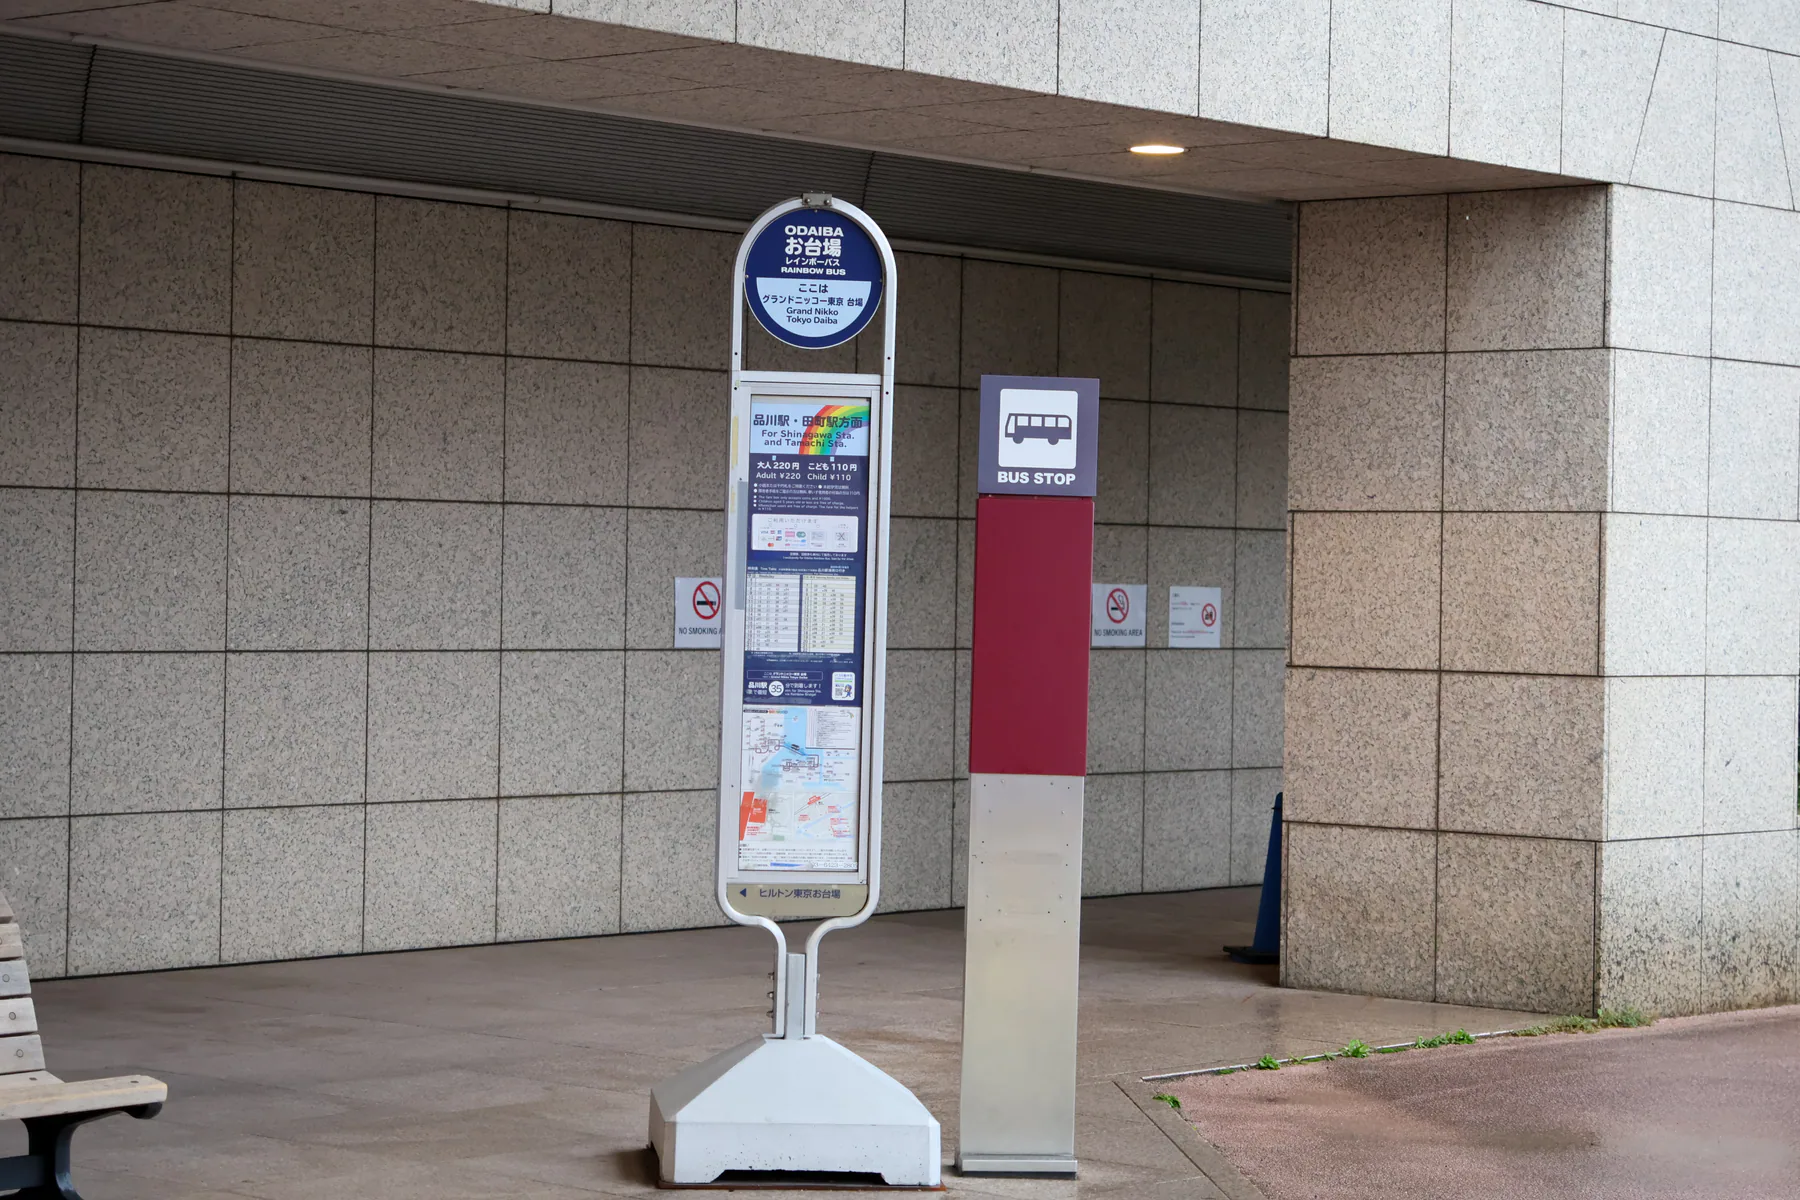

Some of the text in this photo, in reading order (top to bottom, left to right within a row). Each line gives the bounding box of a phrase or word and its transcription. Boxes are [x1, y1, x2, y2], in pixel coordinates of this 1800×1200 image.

[784, 225, 844, 237] ODAIBA
[784, 237, 842, 257] お台場
[785, 257, 840, 266] レインボーバス
[781, 266, 824, 274] RAINBOW
[798, 284, 828, 294] ここは
[786, 307, 838, 316] Grand Nikko
[786, 316, 838, 324] Tokyo Daiba
[754, 414, 862, 428] 品川駅・田町駅方面
[781, 430, 832, 440] Shinagawa
[785, 438, 825, 447] Tamachi
[997, 471, 1076, 485] BUS STOP
[771, 684, 782, 693] 35
[760, 888, 841, 899] ヒルトン東京お台場
